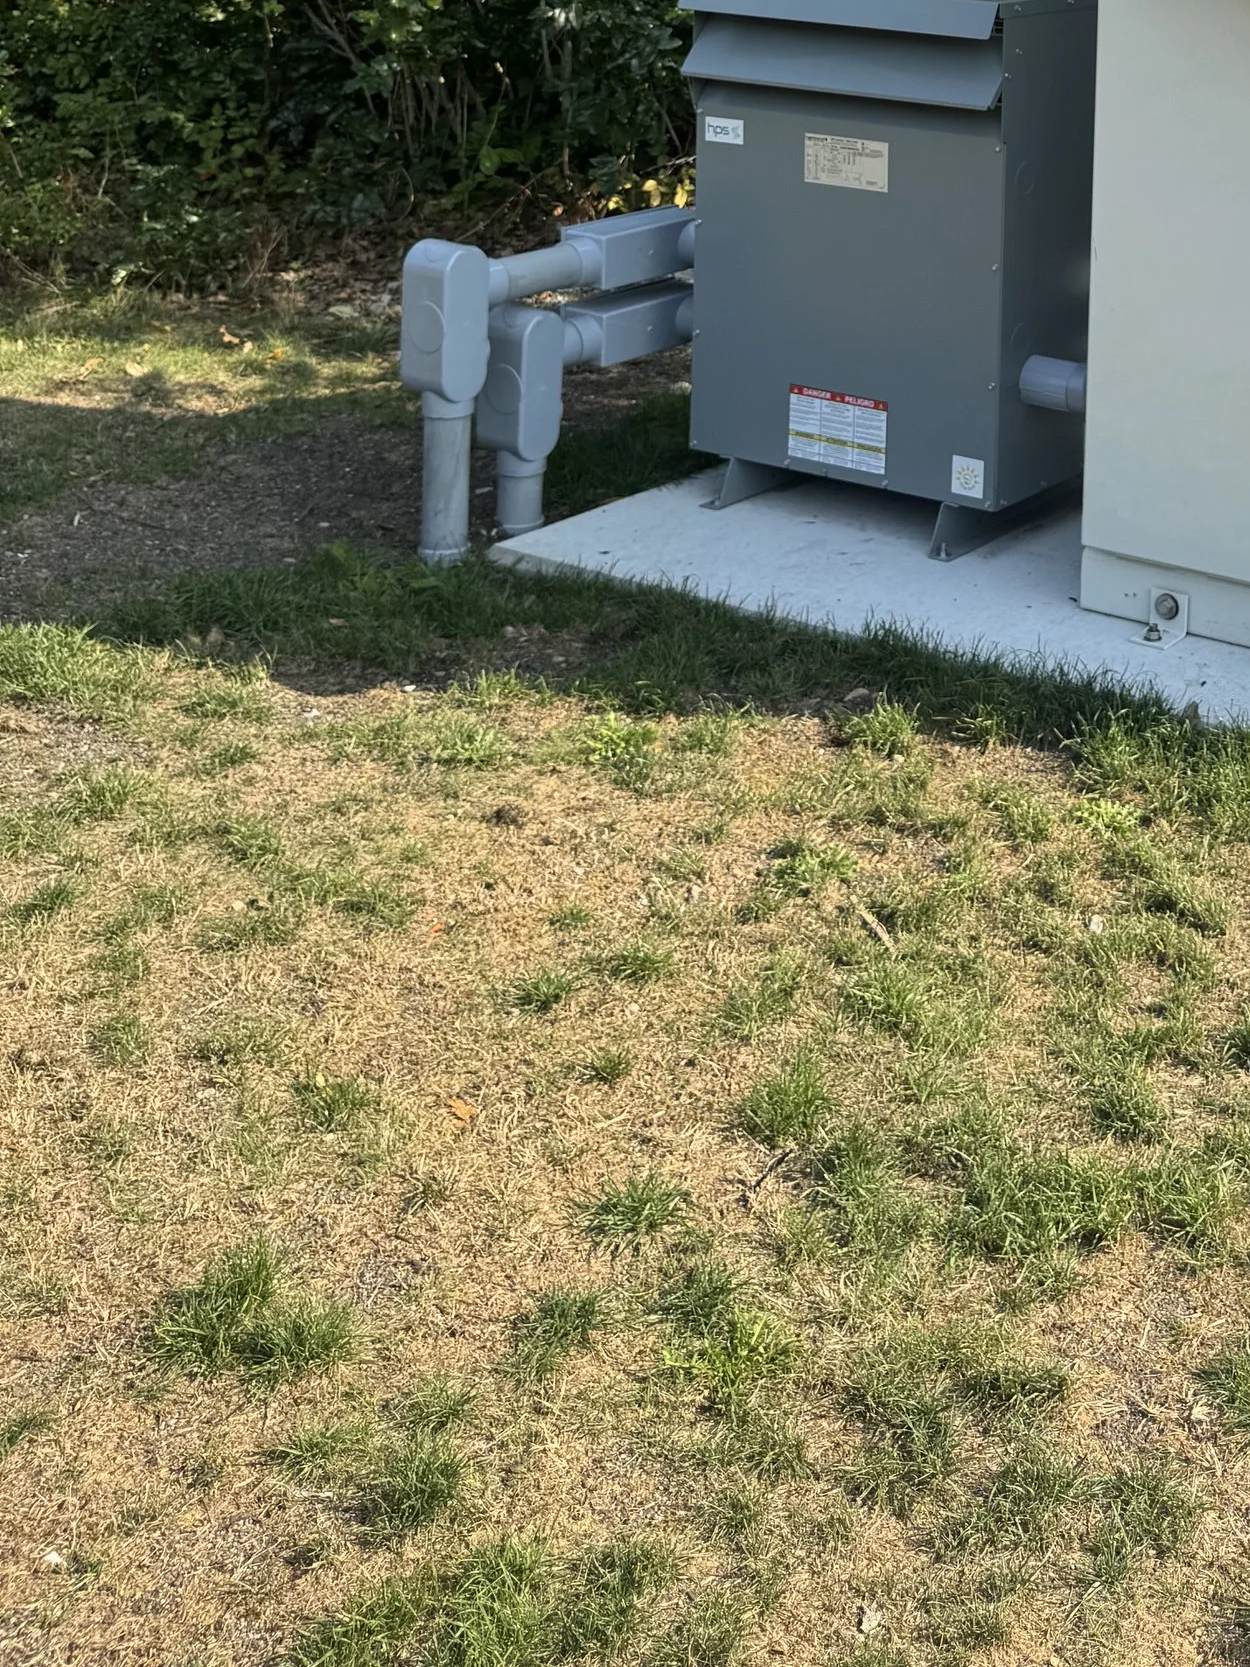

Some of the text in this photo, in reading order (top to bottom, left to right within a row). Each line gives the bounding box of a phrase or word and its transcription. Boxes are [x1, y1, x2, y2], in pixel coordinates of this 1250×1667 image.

[707, 122, 730, 137] hps
[803, 388, 875, 408] DANGER PELIGRO
